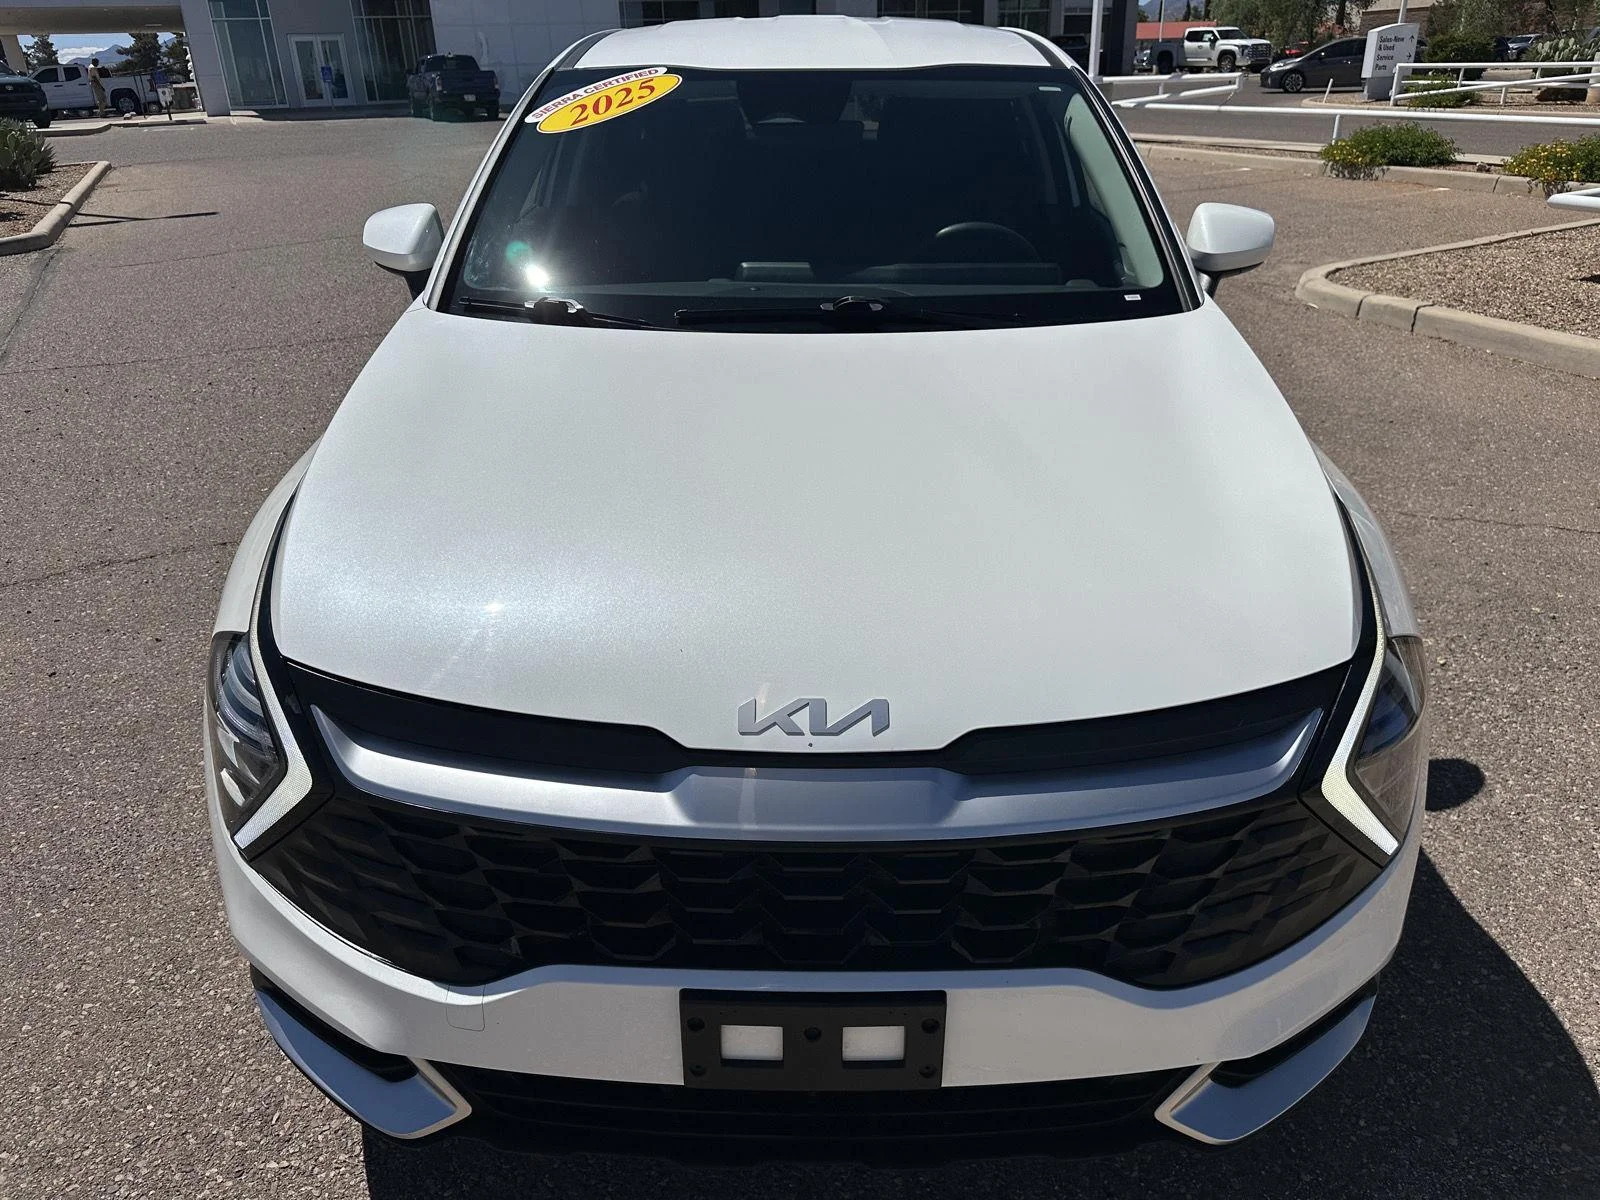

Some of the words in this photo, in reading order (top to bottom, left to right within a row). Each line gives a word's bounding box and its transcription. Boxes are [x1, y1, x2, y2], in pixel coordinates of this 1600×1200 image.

[1379, 35, 1405, 43] Sales-New
[531, 92, 584, 119] SIERRA
[583, 68, 659, 94] CERTIFIED
[569, 78, 656, 126] 2025
[737, 697, 890, 737] KIA
